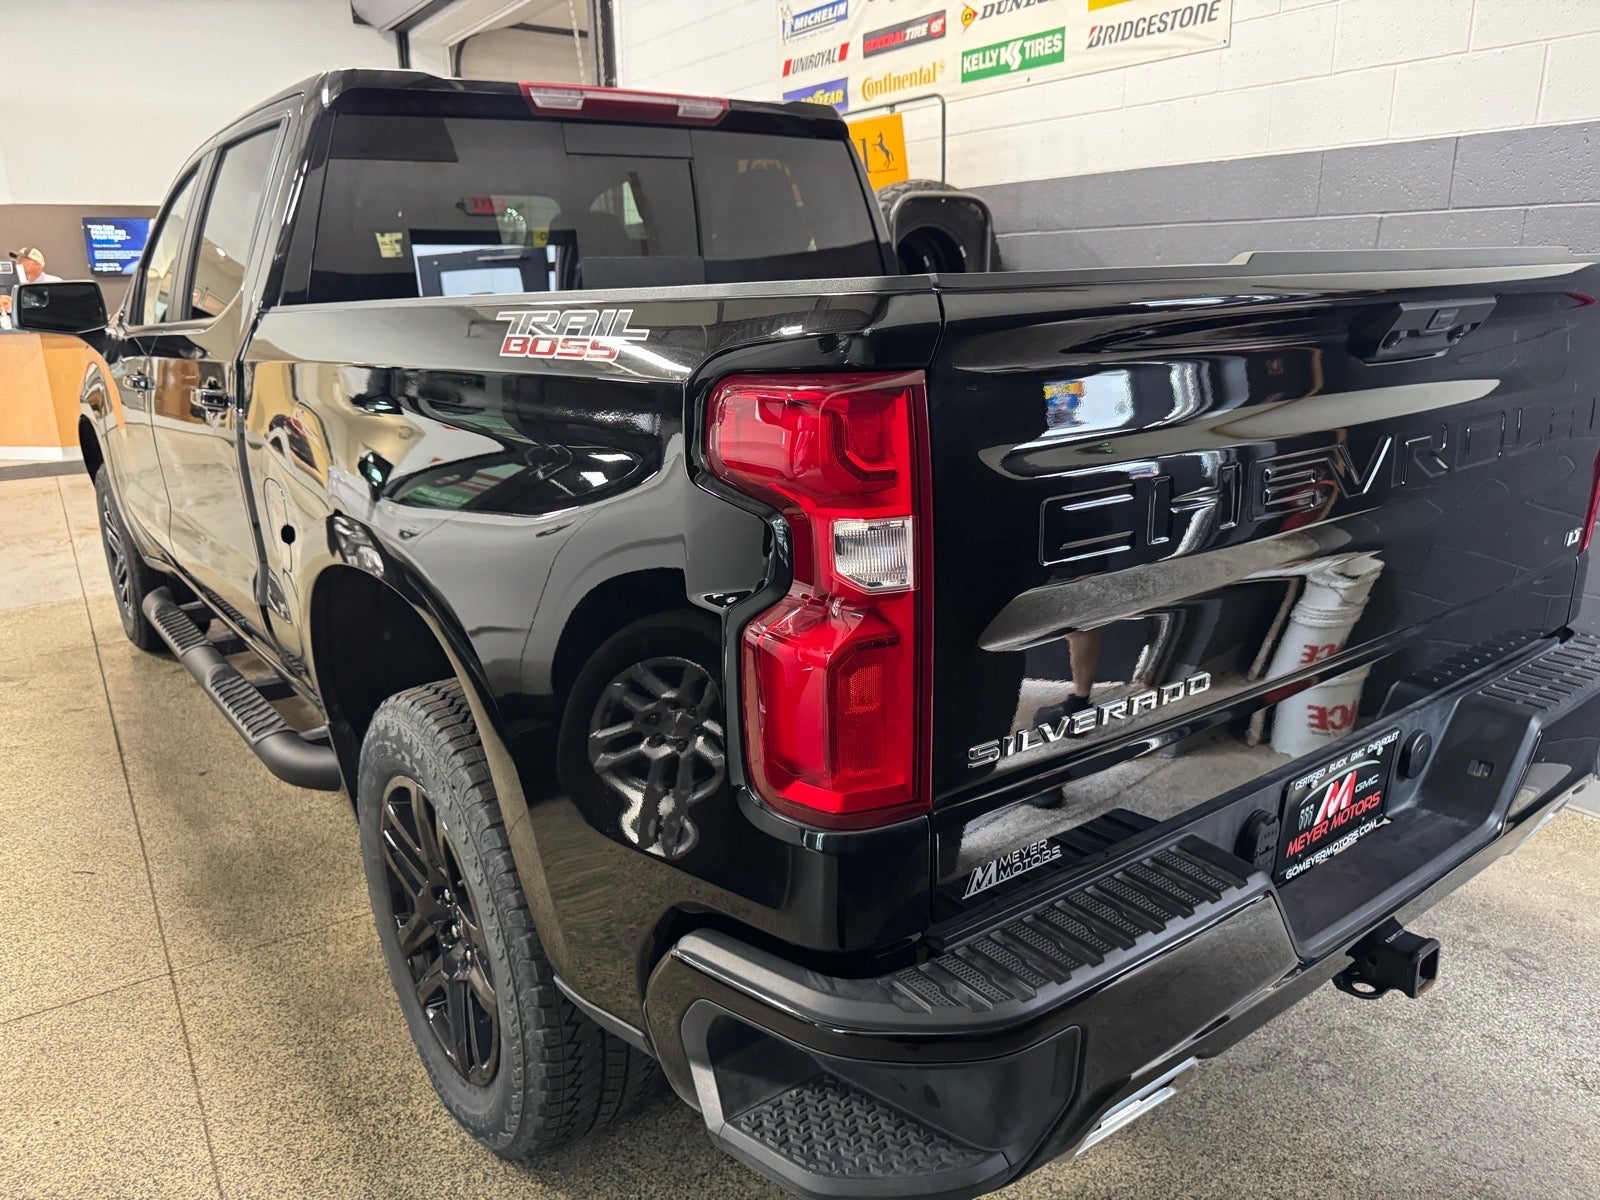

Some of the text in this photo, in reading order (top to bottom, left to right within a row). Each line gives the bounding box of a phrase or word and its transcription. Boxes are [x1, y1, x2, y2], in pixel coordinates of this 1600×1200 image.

[794, 2, 847, 31] MICHELIN
[1086, 0, 1221, 49] BRIDGESTONE
[791, 47, 838, 74] UNIROYAL
[963, 48, 999, 73] KELLY
[1023, 33, 1062, 60] TIRES
[861, 62, 937, 102] Continental
[496, 309, 650, 341] TRAIL
[499, 334, 620, 362] BOSS
[967, 671, 1212, 769] SILVERADO
[1294, 731, 1400, 790] CERTIFIED BUICK GMC CHEVROLET
[1355, 773, 1379, 793] GMC
[1286, 790, 1382, 859] MEYER MOTORS
[998, 839, 1048, 869] MEYER
[999, 845, 1063, 880] MOTORS
[1285, 819, 1378, 880] GOMEYERMOTORS.COM
